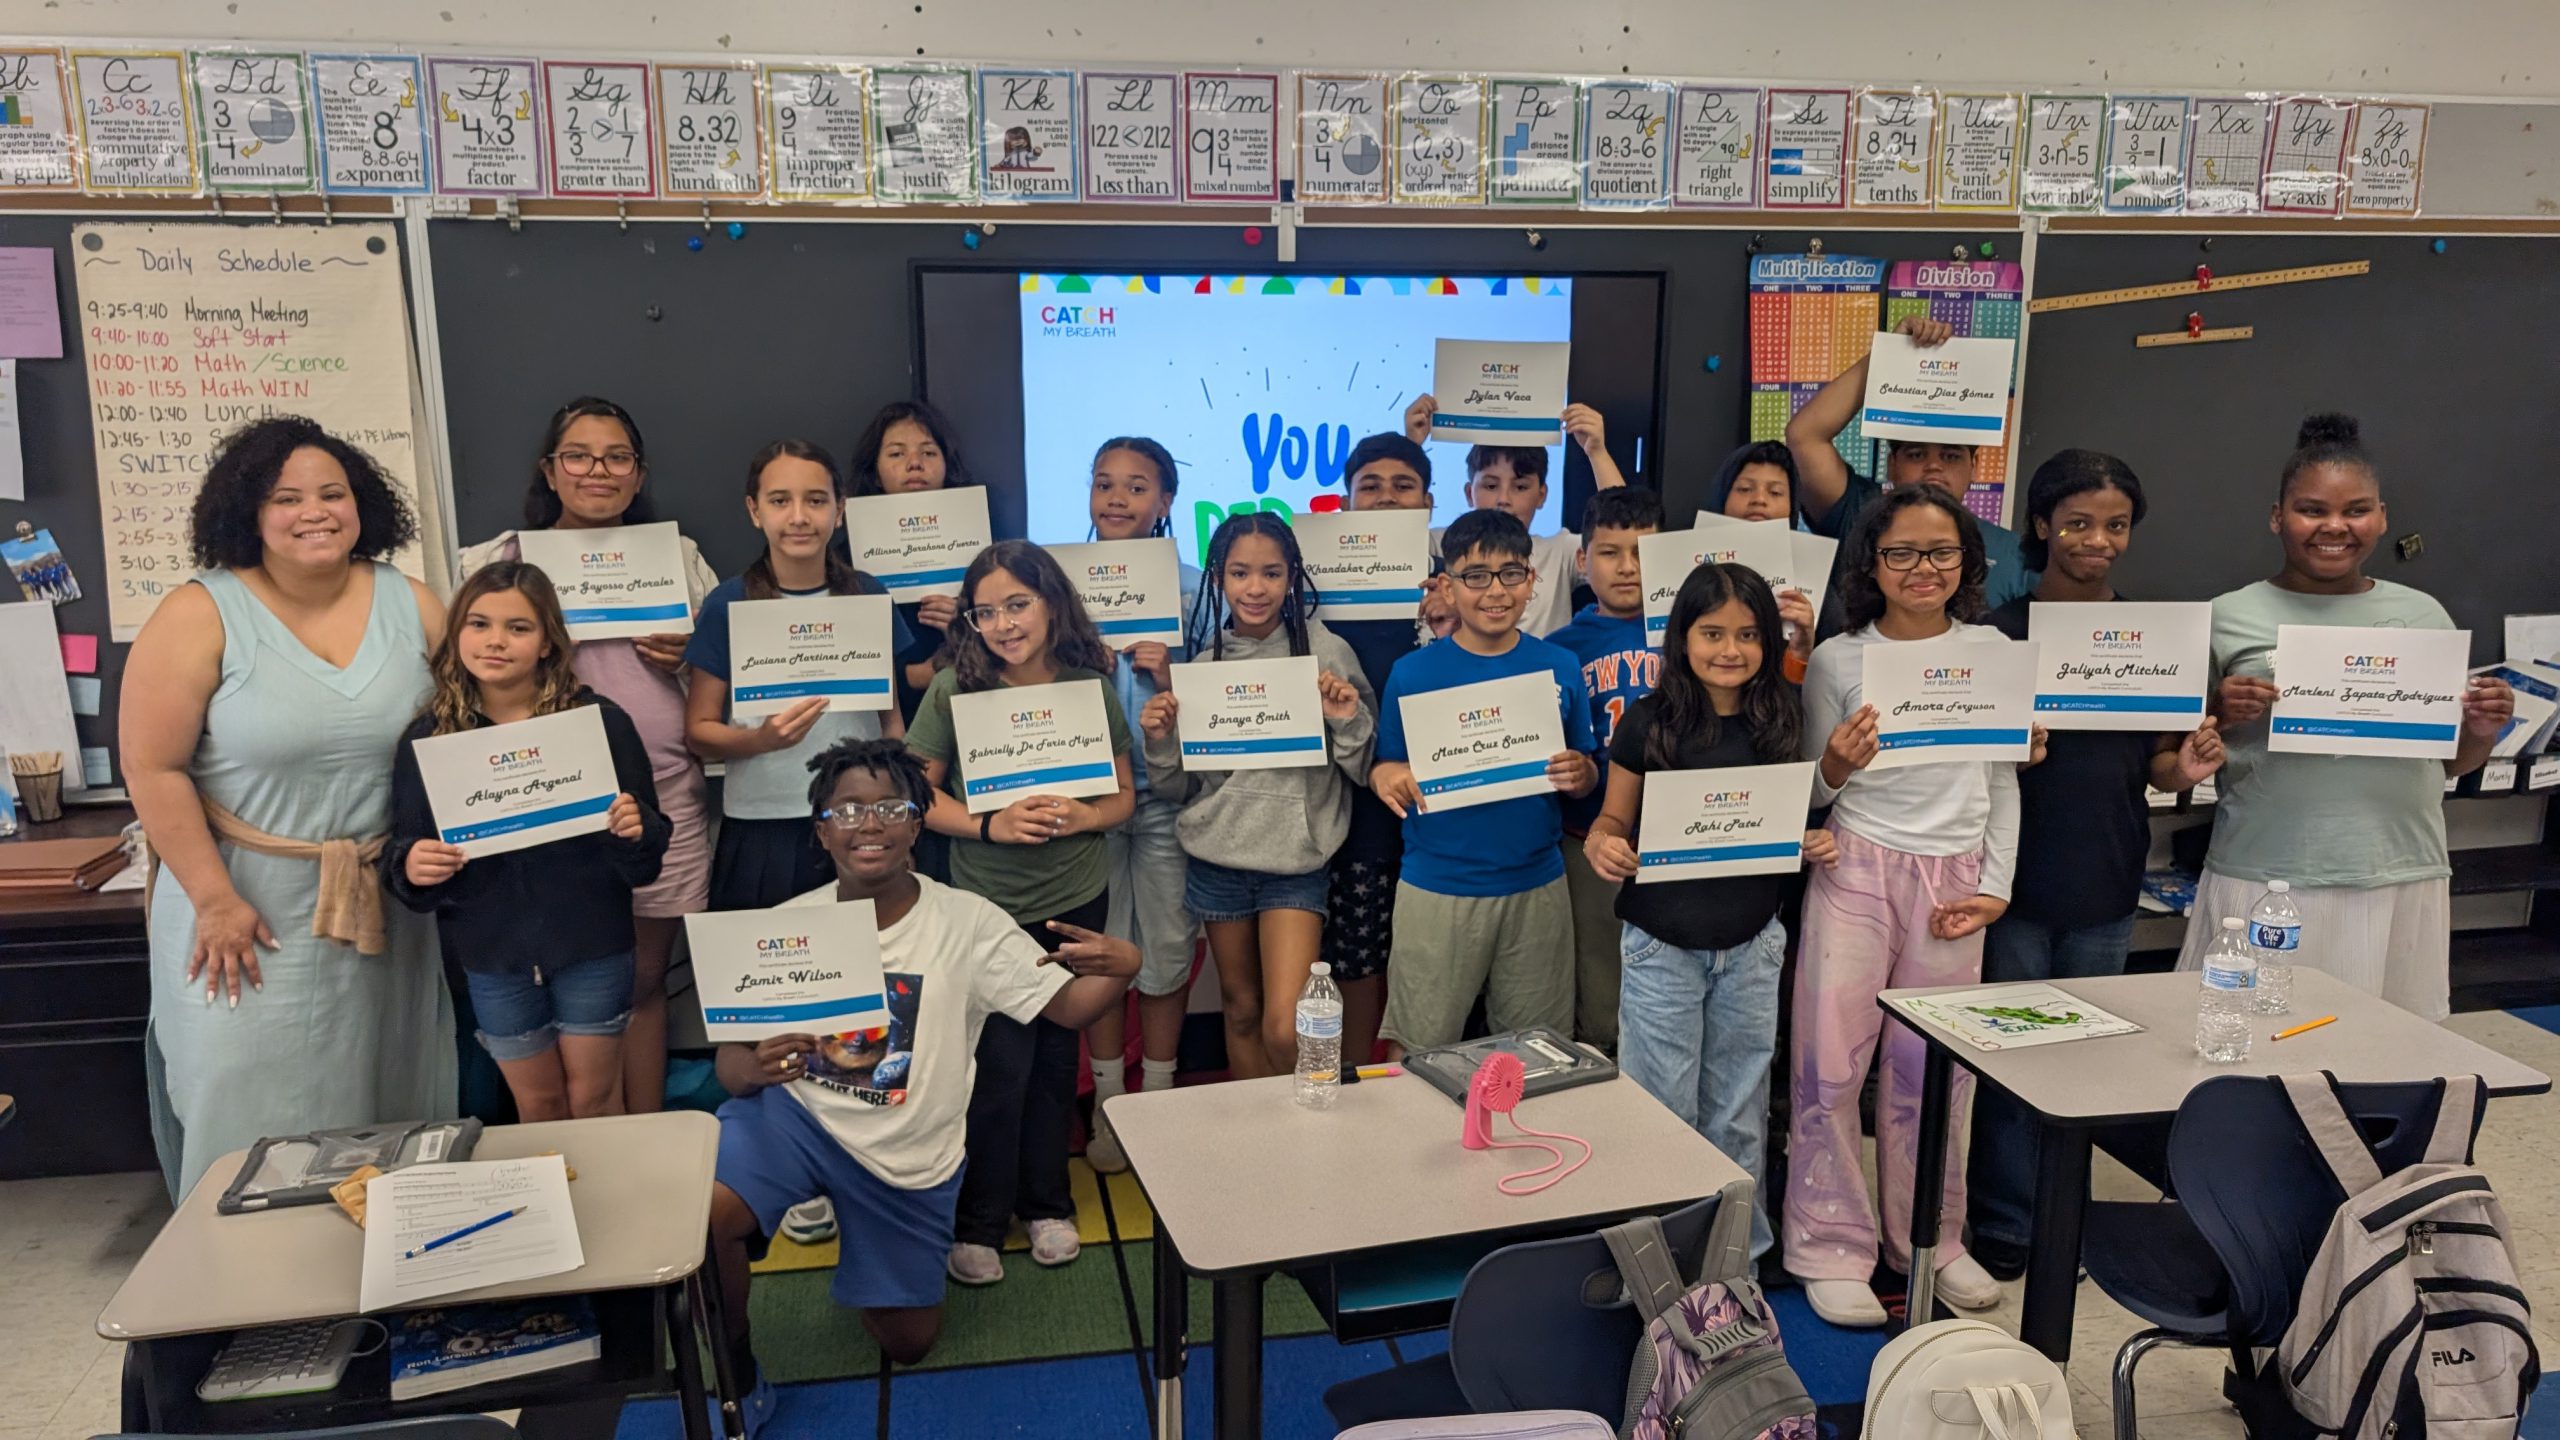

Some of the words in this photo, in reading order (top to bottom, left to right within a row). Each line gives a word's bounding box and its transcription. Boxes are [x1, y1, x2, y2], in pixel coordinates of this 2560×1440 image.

[1402, 116, 1448, 125] horizontal
[91, 143, 188, 156] commutative
[210, 163, 306, 178] denominator
[786, 156, 855, 175] improper
[94, 171, 190, 186] multiplication
[336, 167, 421, 183] exponent
[467, 168, 517, 186] factor
[561, 173, 605, 189] greater
[612, 172, 646, 187] than
[789, 174, 855, 189] fraction
[901, 170, 951, 190] justify
[1700, 166, 1732, 182] right
[1962, 173, 1992, 186] unit
[2139, 171, 2177, 186] whole
[671, 174, 756, 191] hundredth
[989, 173, 1070, 195] kilogram
[1096, 176, 1123, 194] less
[1126, 176, 1169, 194] than
[1193, 181, 1227, 192] mixed
[1229, 181, 1272, 192] number
[1305, 180, 1380, 192] numerator
[1405, 180, 1446, 193] ordered
[1590, 176, 1657, 196] quotient
[1688, 182, 1744, 198] triangle
[1768, 181, 1838, 202] simplify
[1870, 184, 1918, 202] tenths
[1951, 187, 2002, 201] fraction
[2281, 190, 2327, 207] y-axis
[2352, 195, 2373, 205] zero
[2375, 195, 2412, 208] property
[137, 247, 193, 275] Daily
[218, 249, 315, 272] Schedule
[1759, 260, 1875, 280] Multiplication
[1917, 267, 1994, 287] Division
[185, 297, 243, 330] Morning
[252, 297, 309, 327] Meeting
[1041, 306, 1115, 325] CATCH
[193, 326, 231, 348] Soft
[243, 329, 290, 347] Start
[1043, 327, 1061, 337] MY
[1066, 326, 1116, 337] BREATH
[195, 354, 246, 372] Math
[1482, 364, 1518, 373] CATCH
[1920, 360, 1958, 370] CATCH
[201, 379, 254, 397] Math
[261, 379, 309, 397] WIN
[1880, 383, 1927, 396] Sebastian
[1464, 390, 1500, 404] Dylan
[1504, 391, 1531, 402] Vaca
[899, 515, 938, 527] CATCH
[1339, 535, 1376, 544] CATCH
[581, 552, 624, 563] CATCH
[864, 548, 901, 558] Allinson
[1695, 551, 1735, 565] CATCH
[1088, 565, 1126, 575] CATCH
[1366, 562, 1412, 575] Hossain
[552, 582, 576, 595] aya
[580, 581, 624, 594] Gayosso
[627, 577, 674, 590] Morales
[1080, 593, 1112, 607] hirley
[1114, 591, 1145, 606] Lang
[789, 623, 833, 634] CATCH
[2092, 631, 2141, 642] CATCH
[741, 656, 786, 671] Luciana
[789, 653, 839, 665] Martinez
[842, 650, 881, 662] Macias
[2344, 655, 2396, 668] CATCH
[1924, 669, 1971, 679] CATCH
[2056, 663, 2111, 680] Jaliyah
[2115, 664, 2179, 678] Mitchell
[1226, 684, 1265, 695] CATCH
[2282, 686, 2336, 697] Marleni
[1011, 709, 1052, 723] CATCH
[1459, 706, 1500, 723] CATCH
[1893, 701, 1944, 716] Amora
[1946, 702, 1995, 713] Ferguson
[1209, 714, 1252, 729] Janaya
[1256, 711, 1291, 725] Smith
[968, 744, 1014, 762] Gabrielly
[1017, 741, 1034, 756] De
[1069, 734, 1104, 748] Miguel
[1432, 746, 1469, 762] Mateo
[1472, 740, 1499, 753] Cruz
[1502, 733, 1540, 749] Santos
[489, 747, 540, 766] CATCH
[466, 788, 520, 806] Alayna
[523, 770, 583, 795] Argenal
[1704, 791, 1749, 803] CATCH
[1724, 817, 1764, 832] Patel
[2263, 926, 2281, 934] Pure
[2264, 933, 2279, 941] Life
[757, 936, 808, 951] CATCH
[735, 974, 783, 992] Lamir
[788, 969, 842, 983] Wilson
[2431, 1347, 2476, 1368] FILA
